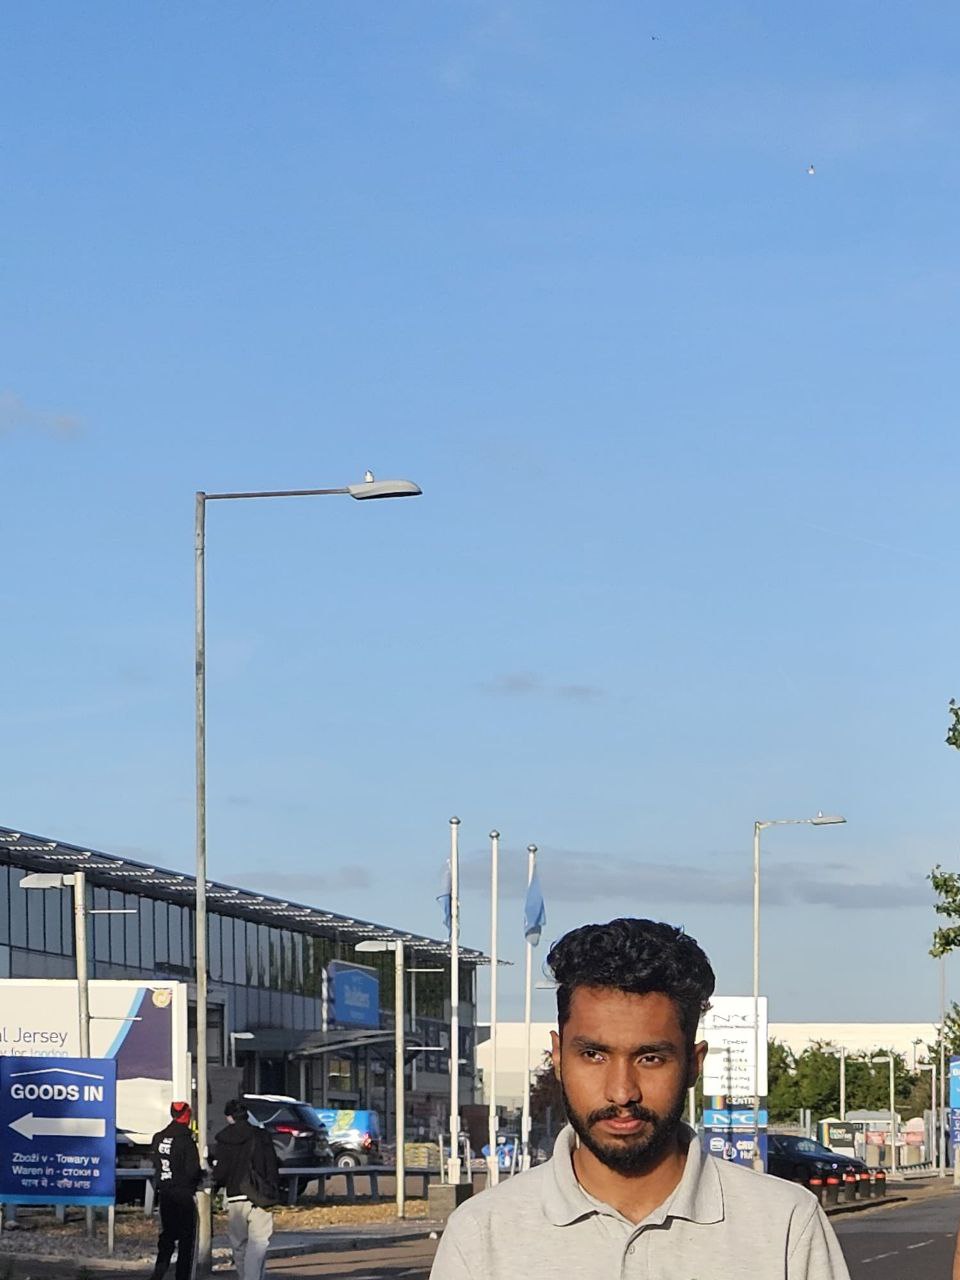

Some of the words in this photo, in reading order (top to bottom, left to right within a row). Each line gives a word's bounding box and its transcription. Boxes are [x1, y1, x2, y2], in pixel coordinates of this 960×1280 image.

[13, 1027, 68, 1047] Jersey
[10, 1083, 80, 1101] GOODS
[83, 1085, 104, 1102] IN
[56, 1153, 90, 1166] Towary
[90, 1156, 100, 1164] w
[12, 1165, 44, 1175] Waren
[45, 1166, 54, 1175] in
